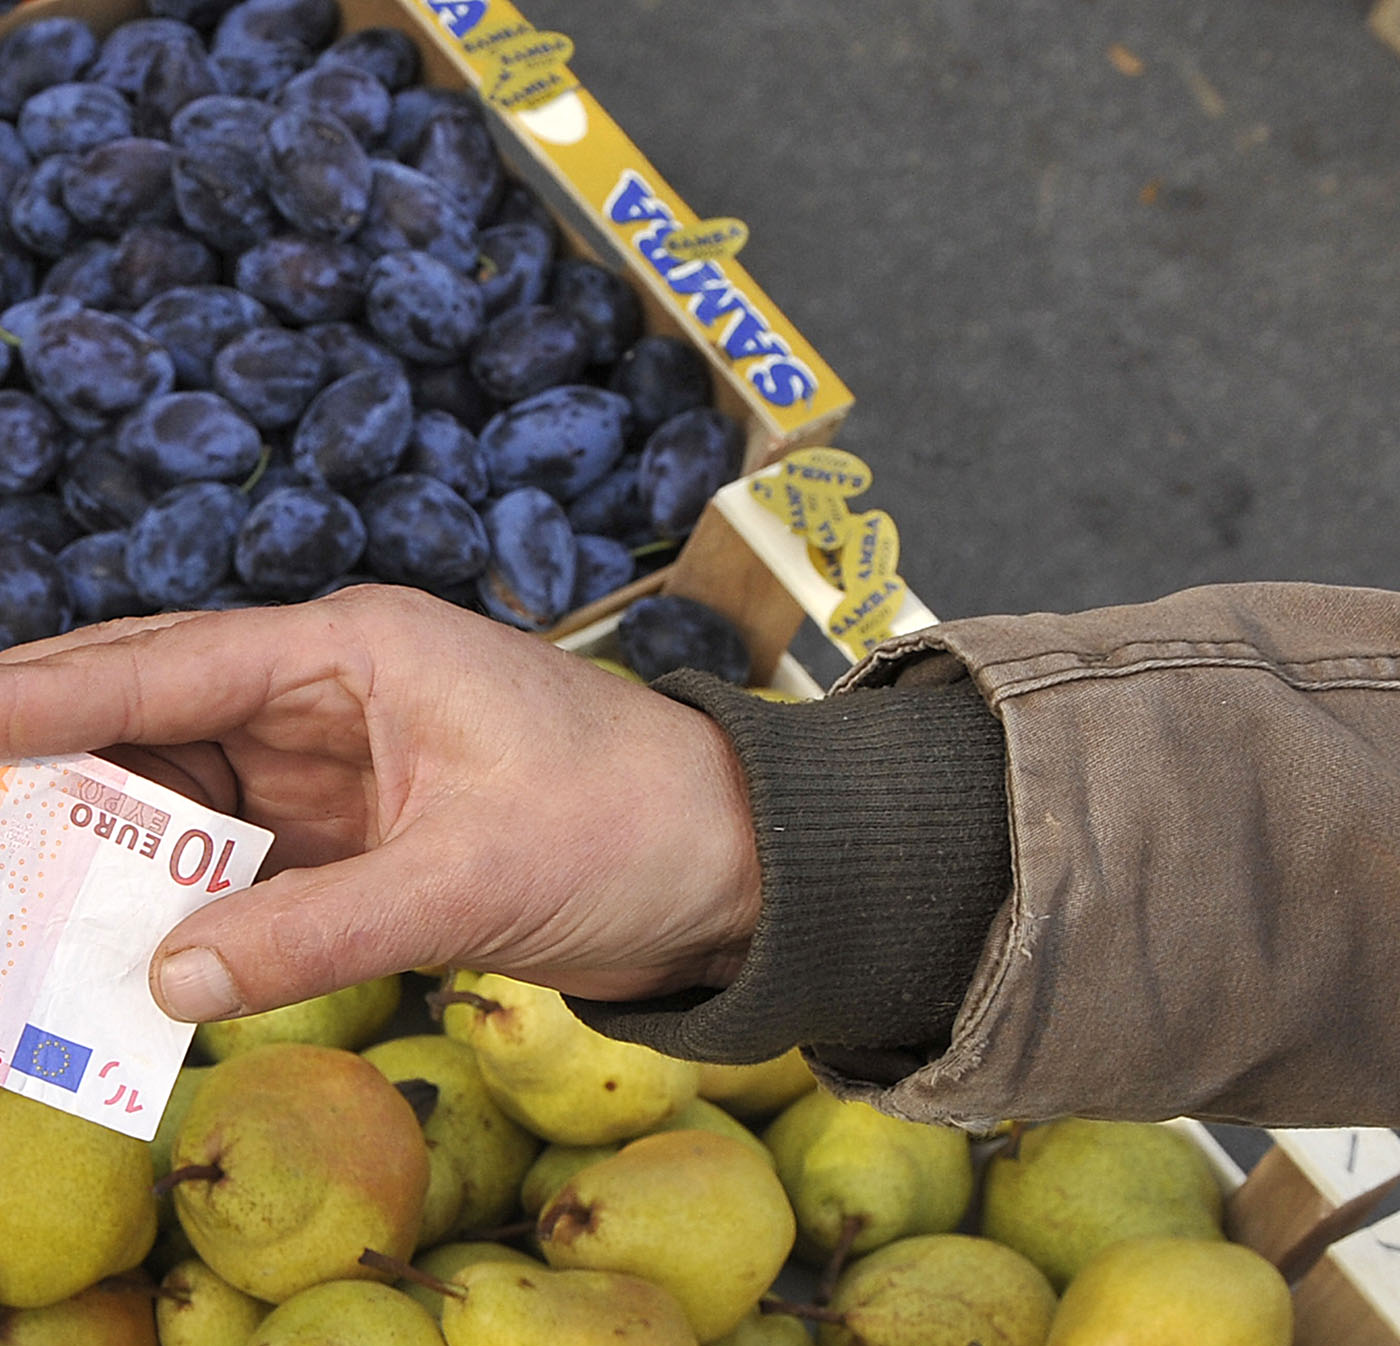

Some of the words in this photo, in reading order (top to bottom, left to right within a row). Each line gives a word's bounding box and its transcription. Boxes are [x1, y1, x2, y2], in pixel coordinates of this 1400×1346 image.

[602, 168, 818, 407] SAMBA
[858, 518, 881, 581] AMBA
[71, 802, 161, 860] EURO
[169, 828, 238, 894] 10
